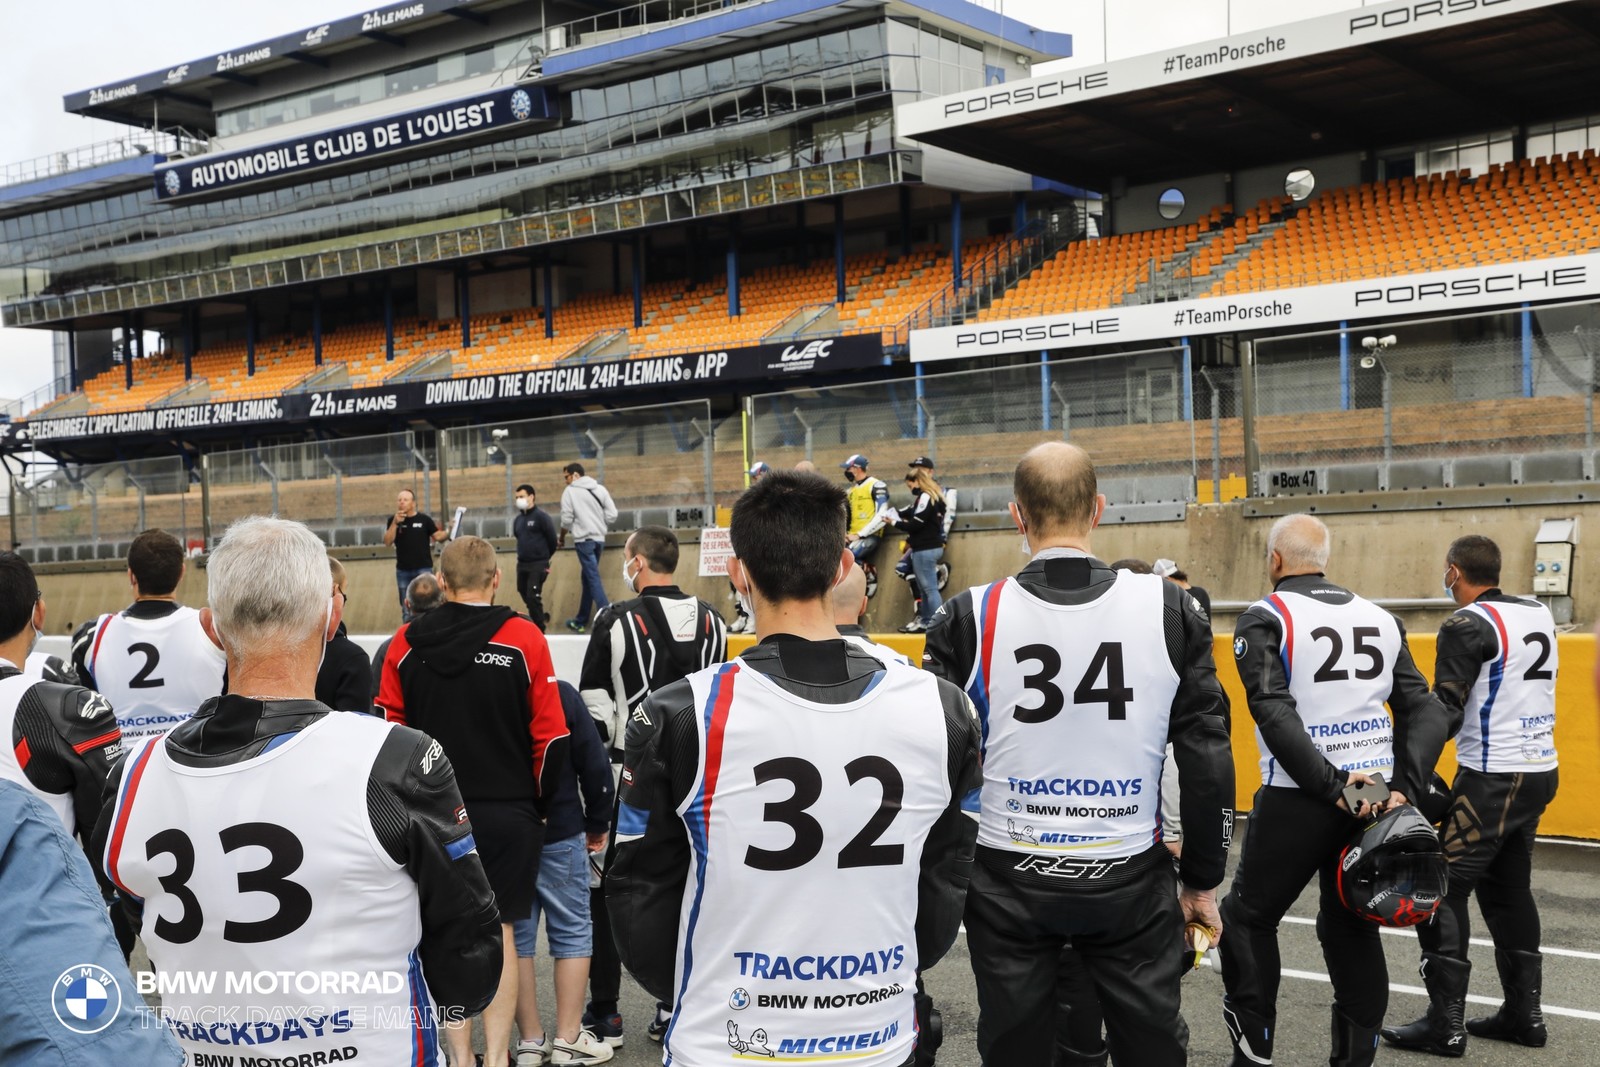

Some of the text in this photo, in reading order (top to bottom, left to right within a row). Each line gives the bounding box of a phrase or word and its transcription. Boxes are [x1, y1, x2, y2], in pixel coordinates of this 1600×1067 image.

[382, 14, 395, 25] LE
[395, 4, 424, 21] MANS
[1350, 0, 1512, 35] PORS
[233, 56, 245, 67] LE
[245, 47, 271, 64] MANS
[1163, 36, 1286, 75] #TeamPorsche
[114, 84, 138, 98] MANS
[944, 71, 1109, 118] PORSCHE
[191, 101, 495, 188] AUTOMOBILE CLUB DE L'OUEST
[1355, 266, 1587, 307] PORSCHE
[1174, 301, 1293, 327] #TeamPorsche
[956, 317, 1120, 348] PORSCHE
[781, 339, 834, 361] WEC
[426, 376, 495, 405] DOWNLOAD
[499, 373, 523, 397] THE
[525, 368, 587, 395] OFFICIAL
[694, 352, 728, 379] APP
[88, 411, 156, 435] L'APPLICATION
[156, 404, 211, 430] OFFICIELLE
[338, 399, 355, 414] LE
[356, 395, 397, 413] MANS
[1281, 470, 1316, 488] Box 47
[127, 641, 165, 689] 2
[474, 653, 513, 667] CORSE
[1310, 626, 1385, 683] 25
[1522, 629, 1558, 681] 2
[1012, 641, 1134, 724] 34
[1308, 716, 1392, 738] TRACKDAYS
[1326, 742, 1351, 752] BMW
[1008, 776, 1143, 797] TRACKDAYS
[743, 755, 905, 871] 32
[1026, 804, 1139, 818] BMW MOTORRAD
[1014, 854, 1132, 878] RST
[145, 822, 312, 944] 33
[733, 944, 905, 980] TRACKDAYS
[757, 983, 905, 1009] BMW MOTORRAD
[165, 1010, 354, 1046] TRACKDAYS
[777, 1020, 899, 1054] MICHELIN
[194, 1046, 358, 1067] BMW MOTORRAD
